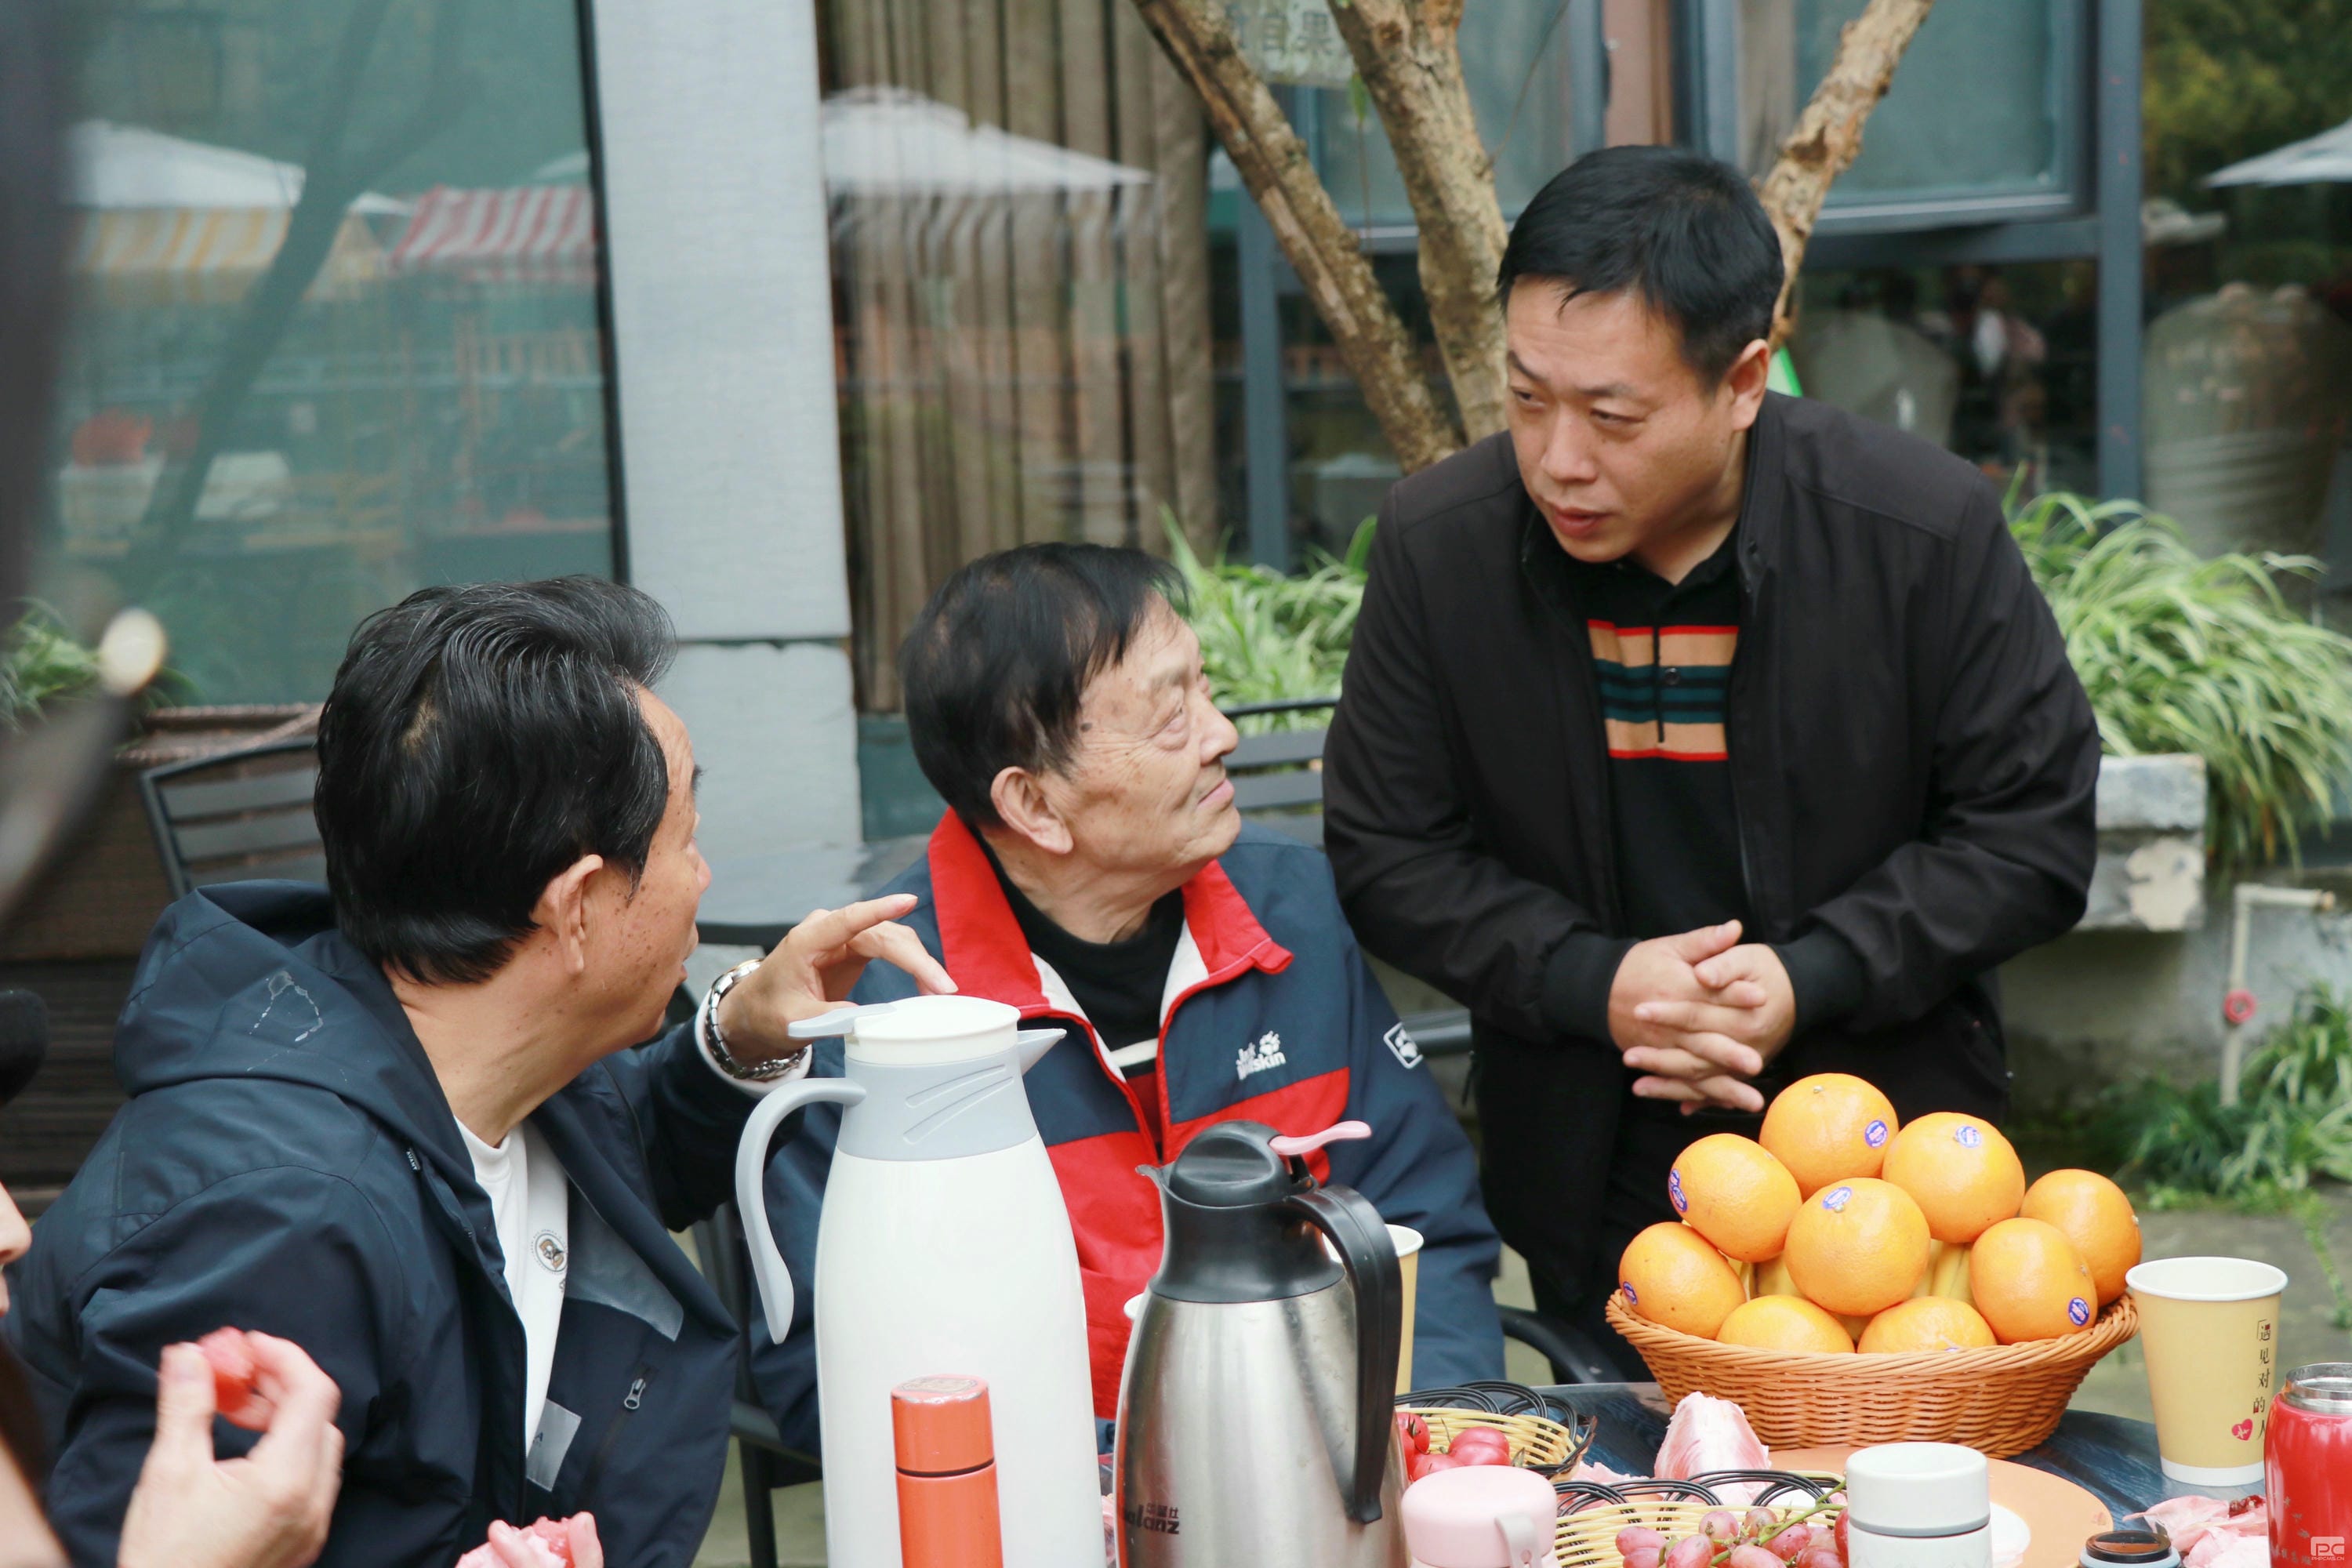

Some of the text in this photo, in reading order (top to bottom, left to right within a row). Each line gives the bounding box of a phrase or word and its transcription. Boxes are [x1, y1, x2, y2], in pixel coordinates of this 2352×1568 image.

[2253, 1321, 2270, 1441] 遇见对的人
